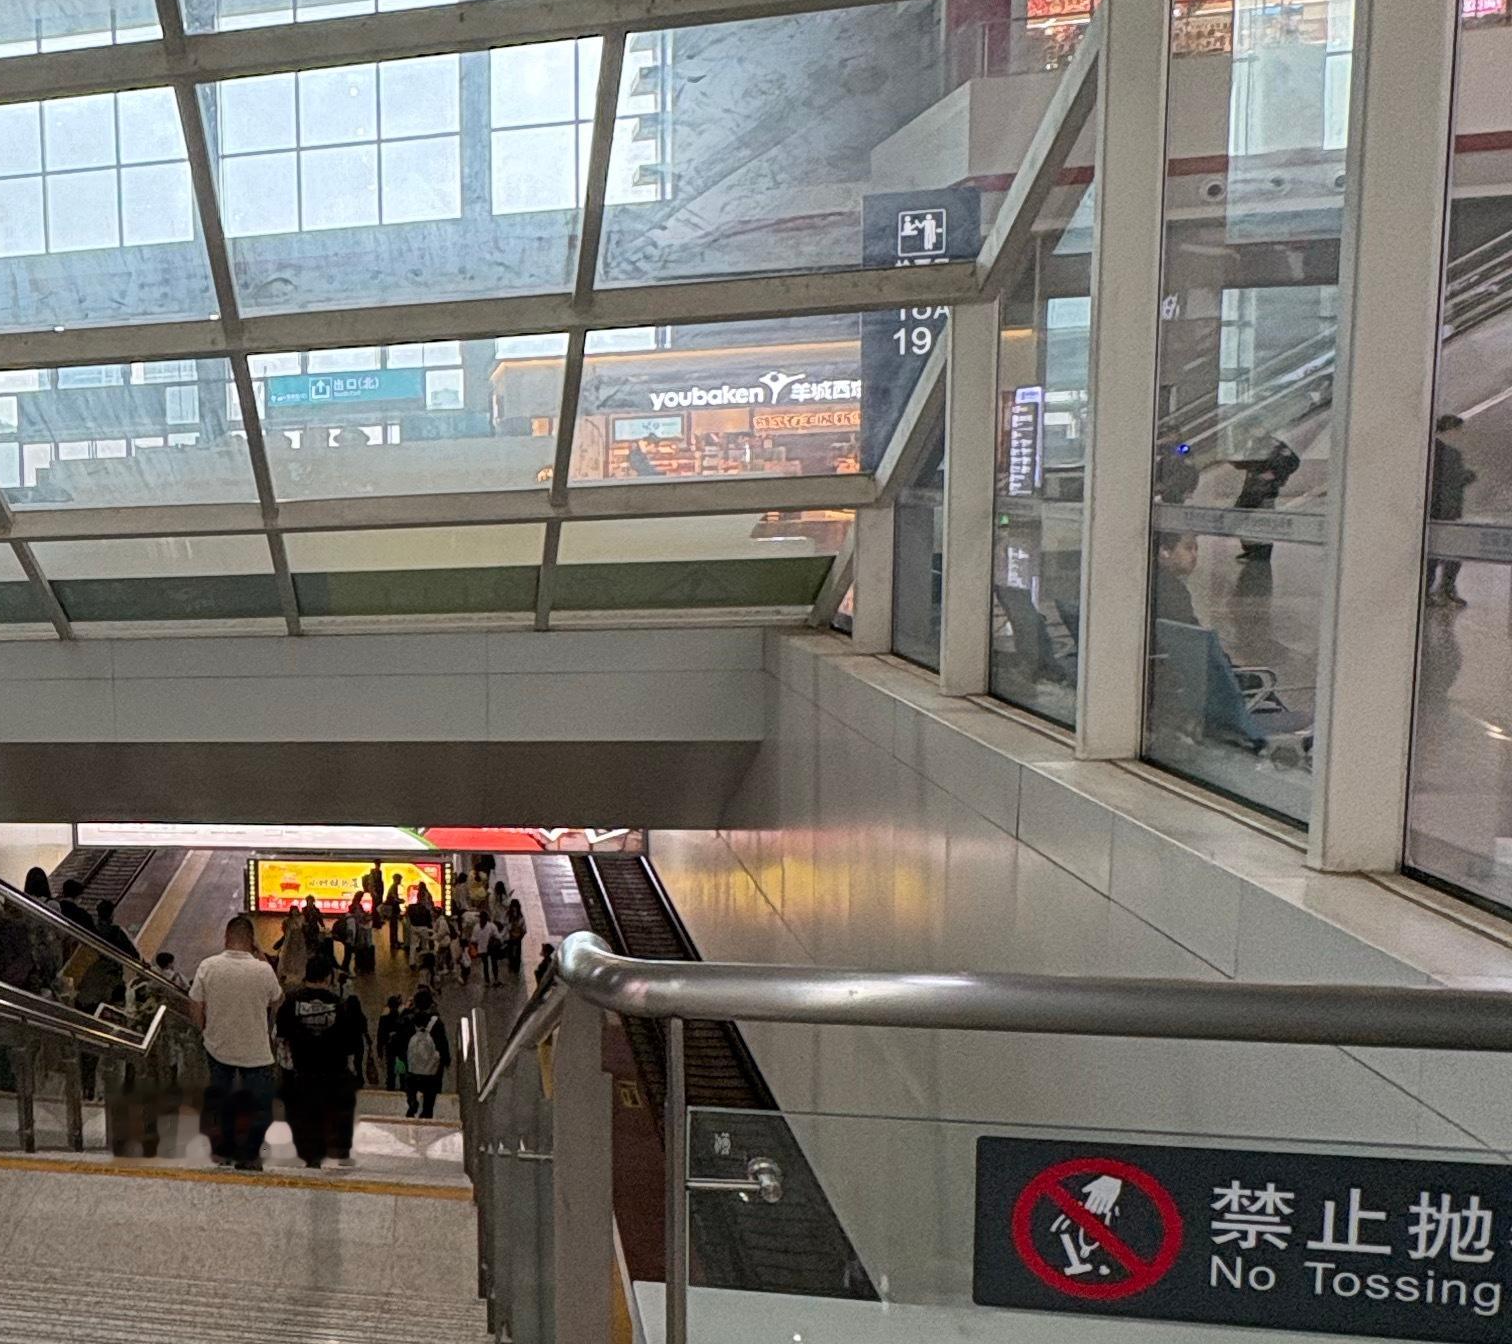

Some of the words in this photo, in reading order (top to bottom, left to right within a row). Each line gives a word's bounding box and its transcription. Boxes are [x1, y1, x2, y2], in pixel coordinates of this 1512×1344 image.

[893, 326, 932, 355] 19
[650, 385, 764, 411] youbaken
[1210, 1180, 1512, 1263] 禁止抛
[1210, 1256, 1276, 1292] No
[1303, 1260, 1501, 1317] Tossing
